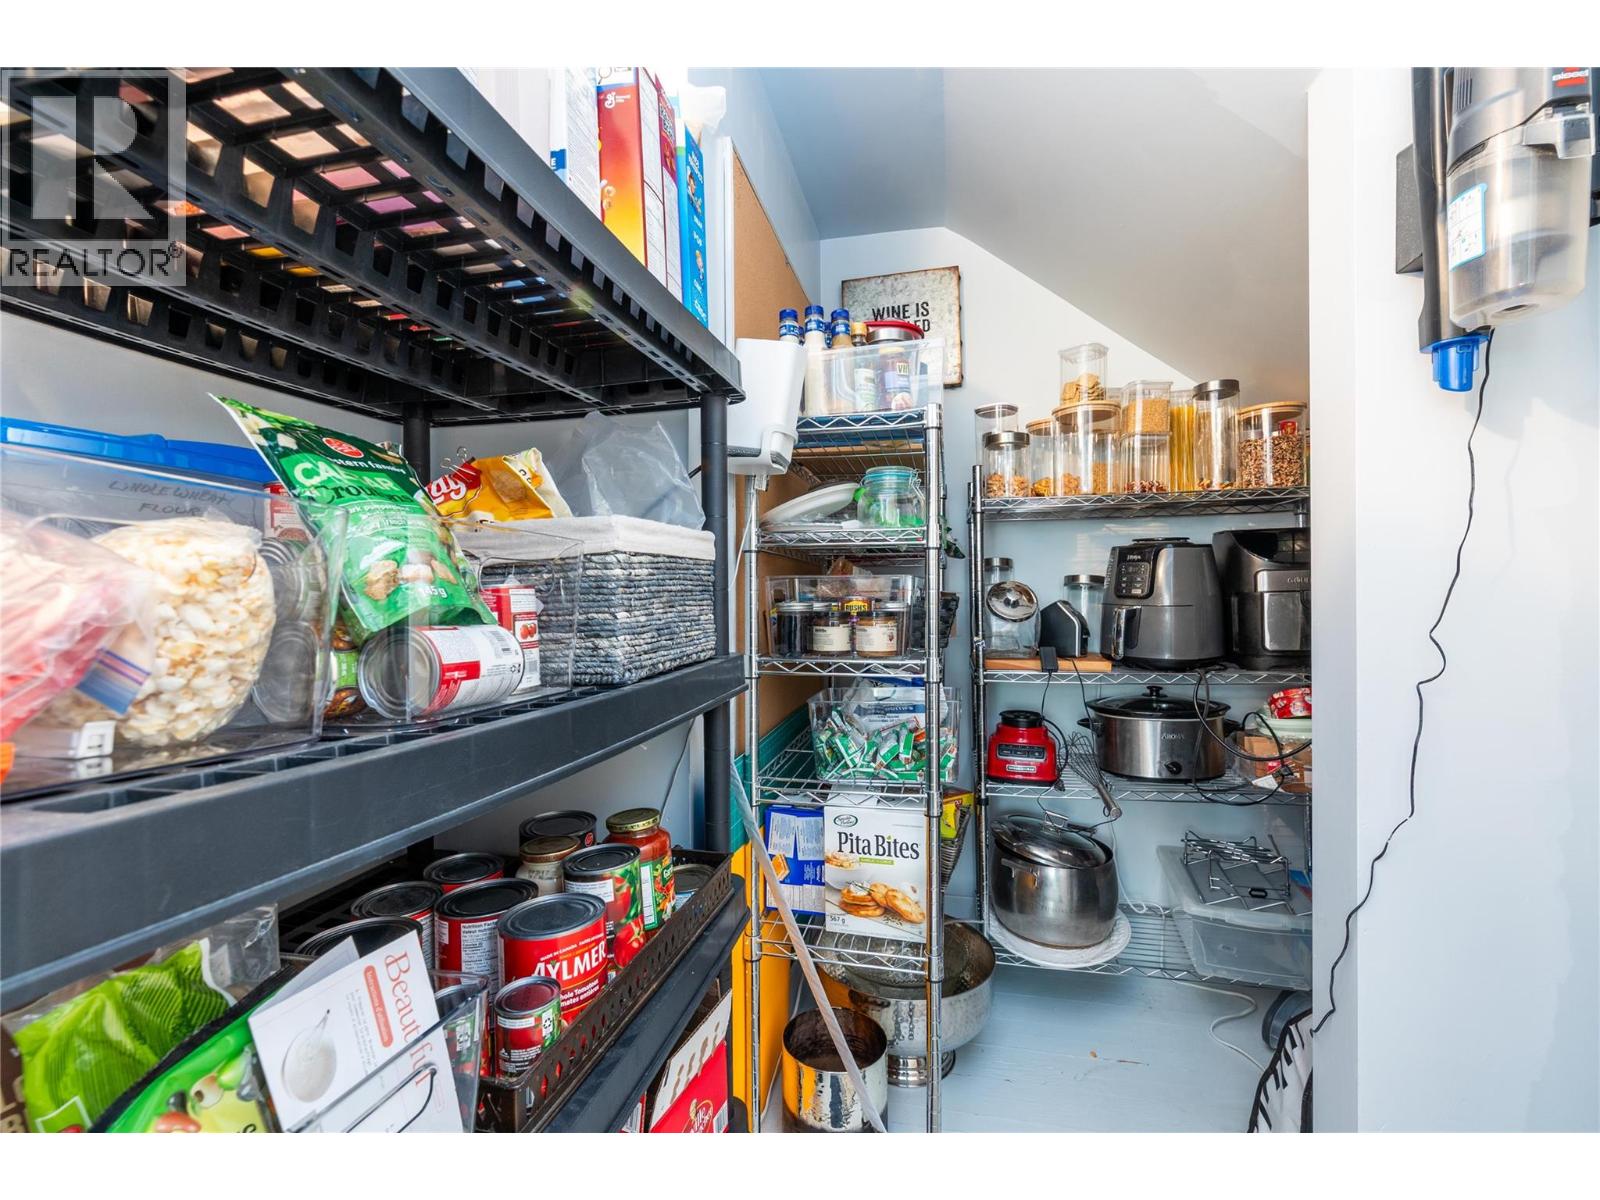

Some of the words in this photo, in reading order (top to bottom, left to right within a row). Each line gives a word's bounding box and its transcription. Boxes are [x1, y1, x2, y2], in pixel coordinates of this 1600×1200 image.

[872, 304, 910, 322] WINE
[915, 301, 930, 317] IS
[108, 480, 170, 497] WHOLE
[139, 502, 201, 516] FLOUR
[837, 831, 872, 856] Pita
[874, 834, 920, 860] Bites
[829, 915, 840, 923] 567
[532, 942, 606, 980] AYLMER
[560, 991, 574, 1001] hole
[560, 998, 580, 1008] mates
[385, 952, 432, 1086] Beautful
